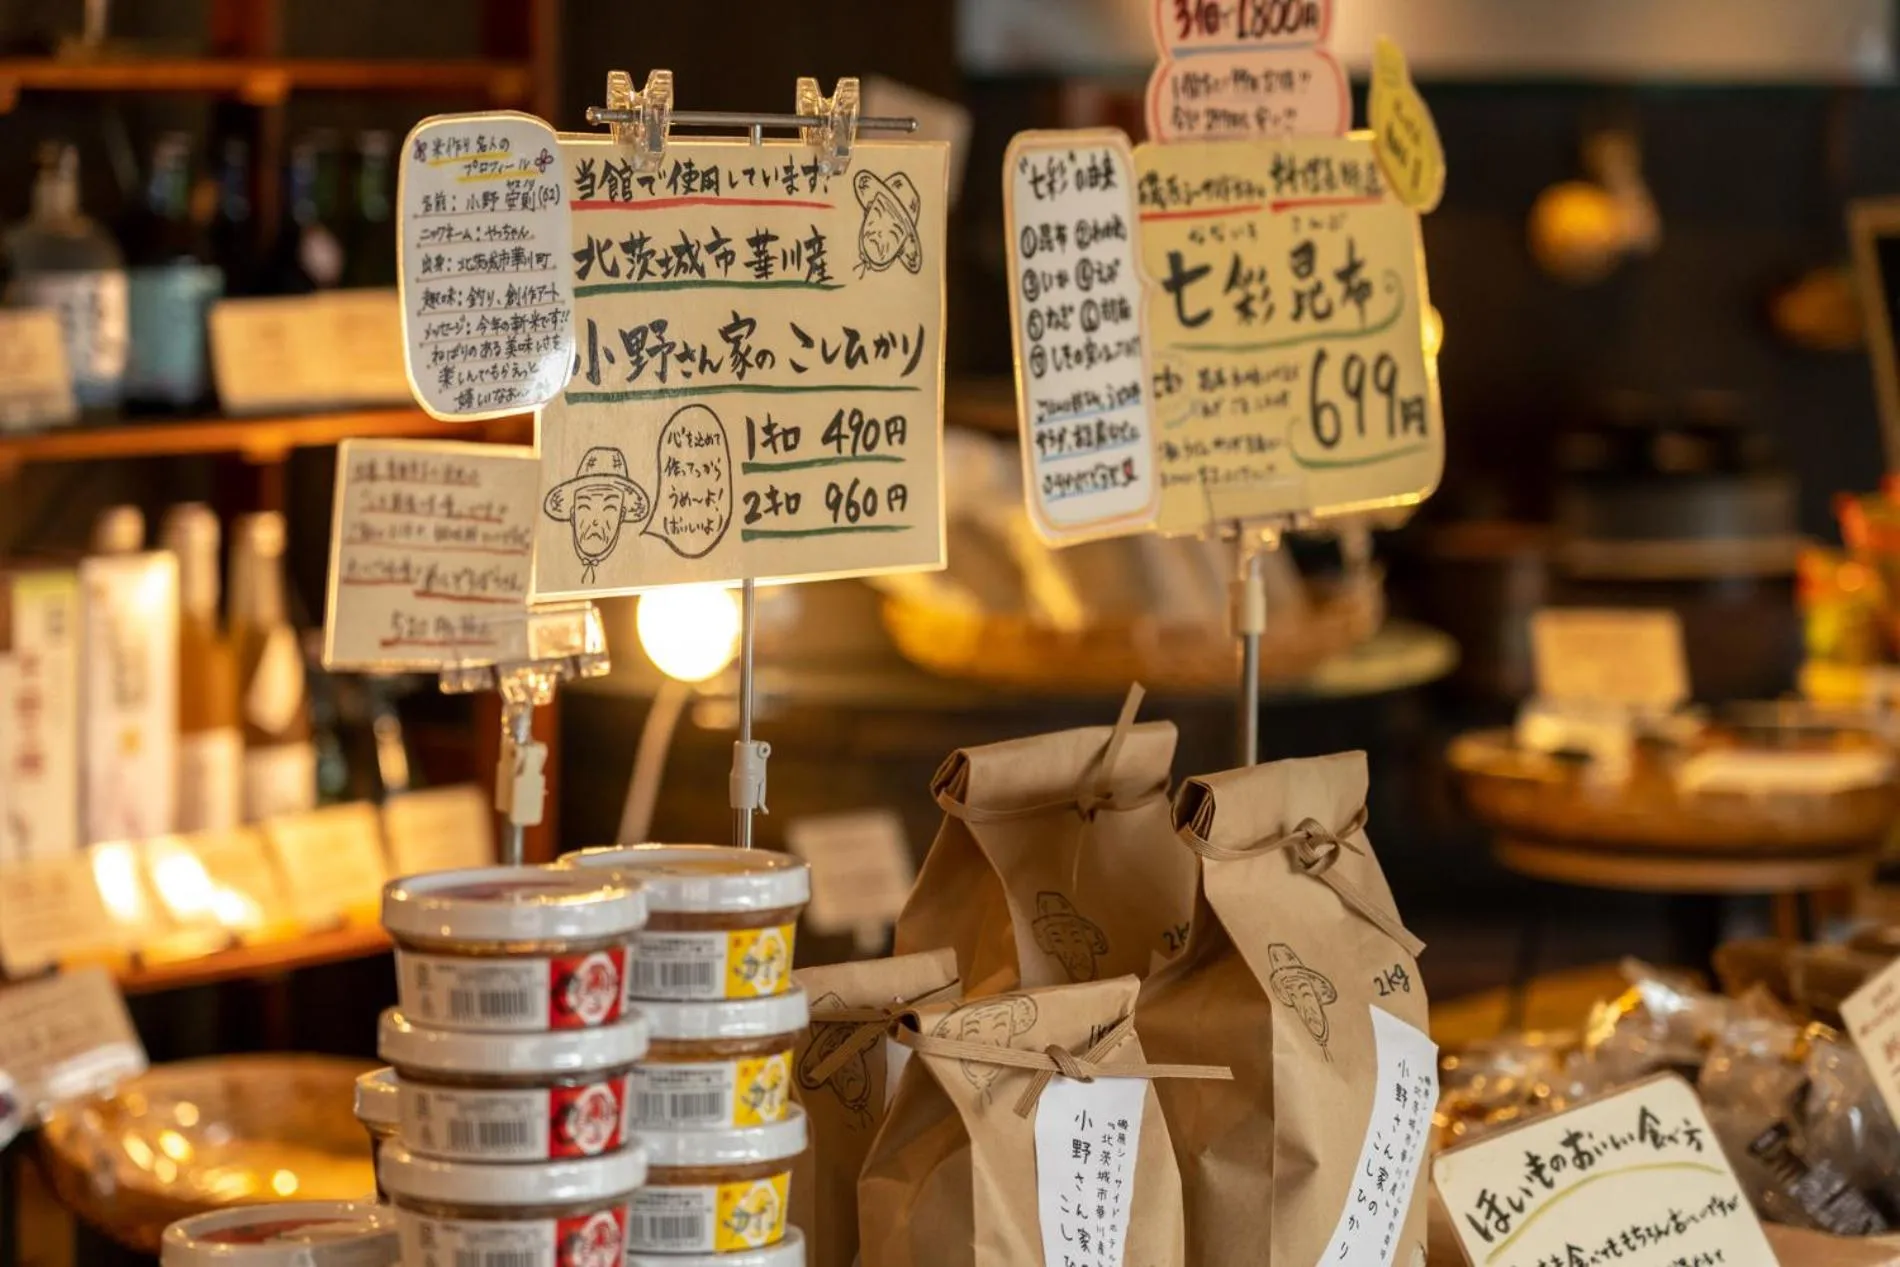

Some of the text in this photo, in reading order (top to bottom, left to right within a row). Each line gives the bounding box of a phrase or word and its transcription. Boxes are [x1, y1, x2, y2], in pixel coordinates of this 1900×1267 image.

[463, 158, 531, 177] プロフィール
[572, 225, 835, 284] 北茨城市華川産
[1310, 348, 1429, 452] 699円
[745, 408, 907, 461] 1キロ 490円
[742, 477, 908, 525] 2キロ 960円
[1162, 920, 1191, 951] 2k
[1373, 963, 1410, 997] 2kg
[1071, 1109, 1093, 1267] 小野さん家
